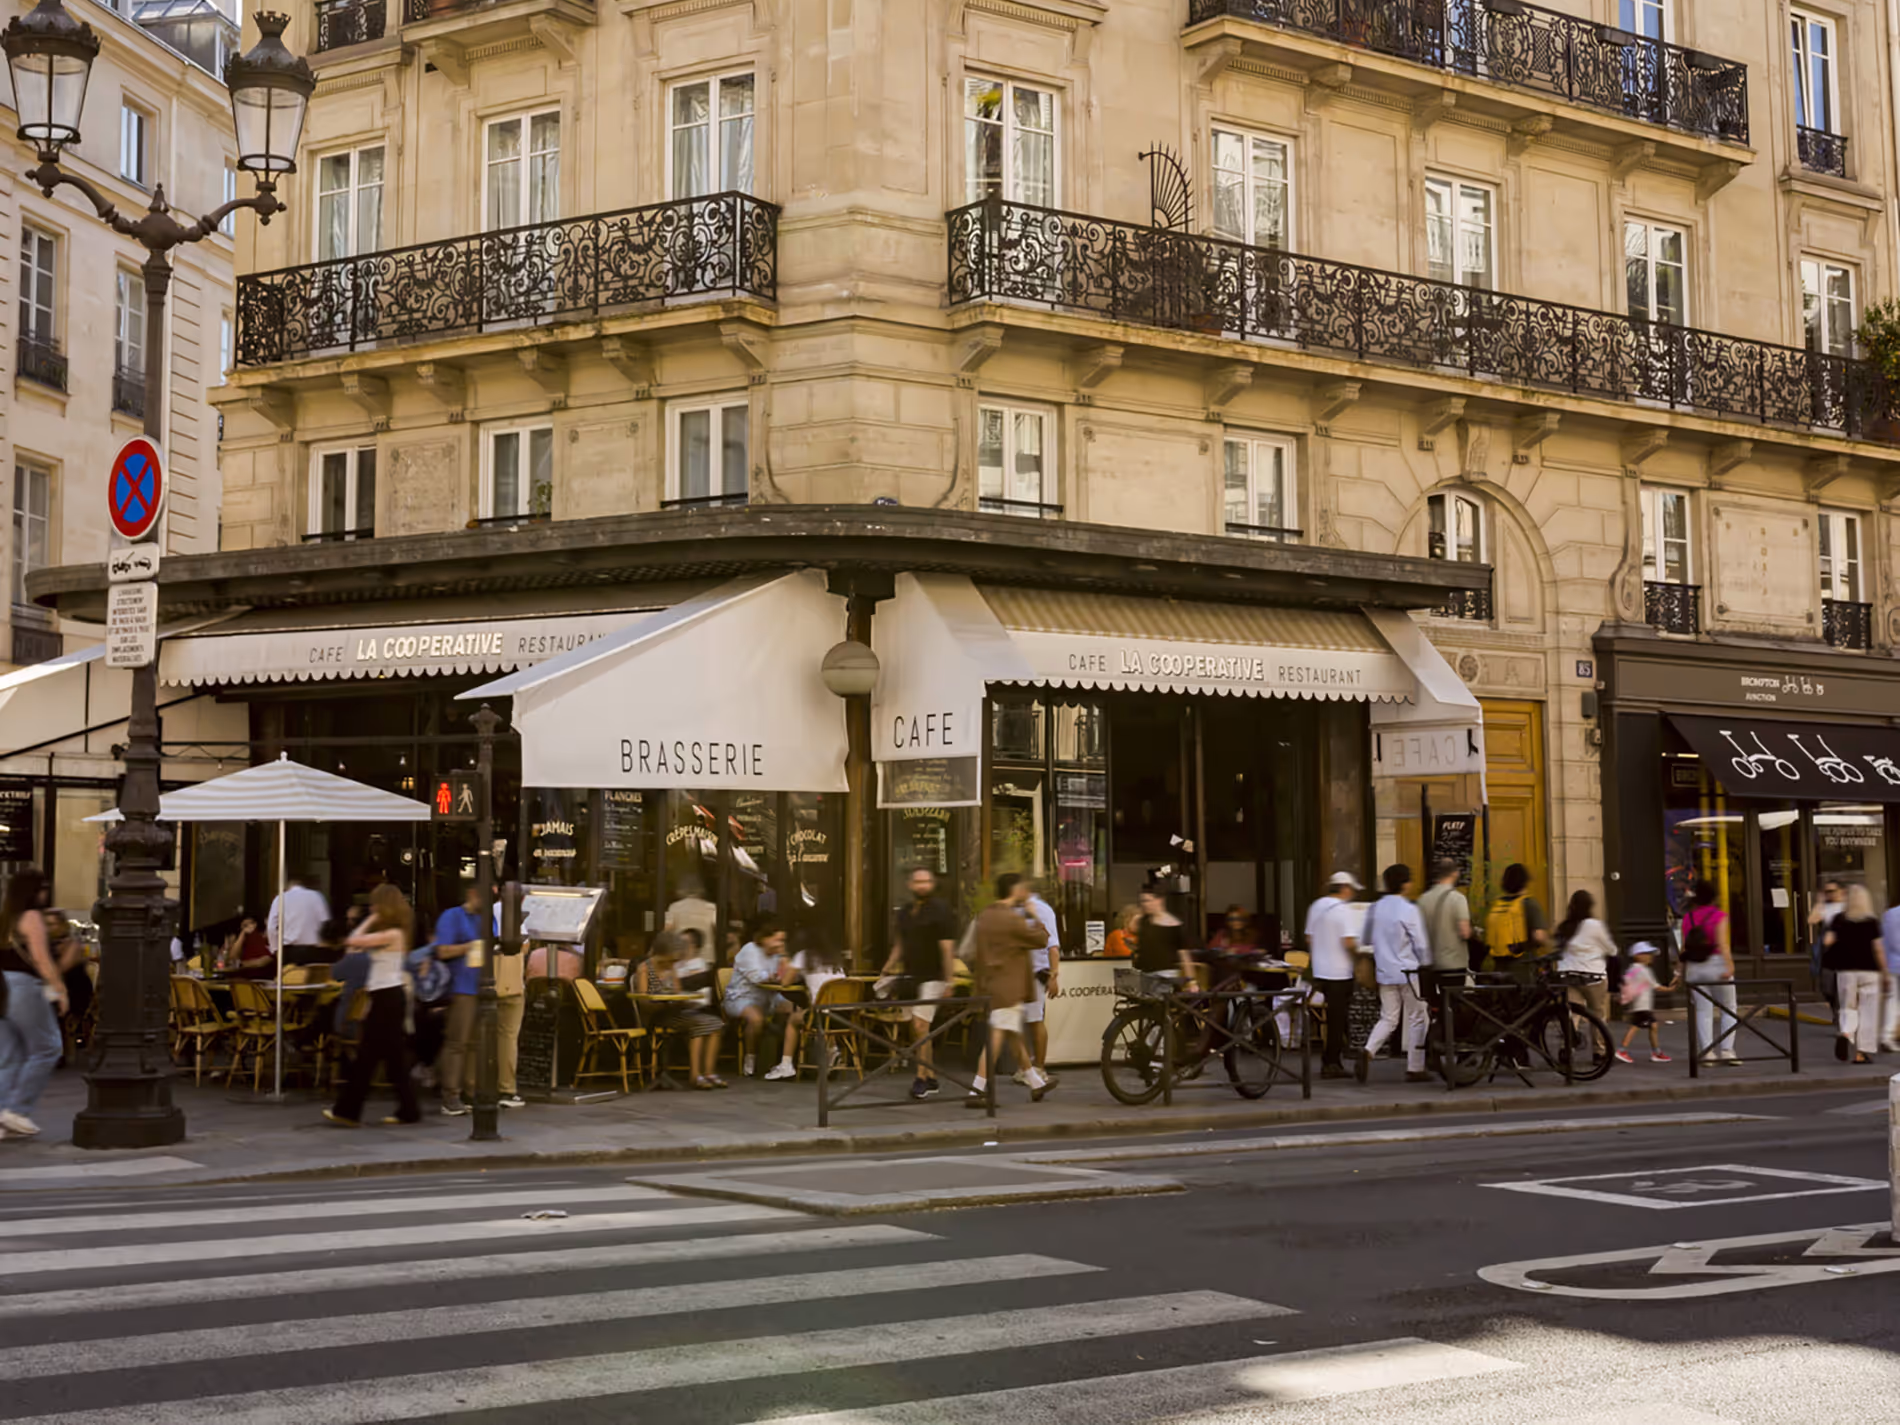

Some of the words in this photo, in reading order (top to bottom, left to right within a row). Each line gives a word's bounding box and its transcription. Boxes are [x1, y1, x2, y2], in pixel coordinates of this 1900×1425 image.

[309, 646, 344, 663] CAFE
[356, 637, 378, 661] LA
[383, 632, 504, 660] COOPERATIVE
[518, 633, 609, 653] RESTAURA
[1068, 653, 1106, 673] CAFE
[1120, 650, 1143, 675] LA
[1149, 652, 1264, 682] COOPERATIVE
[1278, 665, 1362, 685] RESTAURANT
[1578, 662, 1592, 676] 85
[1740, 676, 1780, 688] BROMPTON
[1745, 692, 1777, 703] JUNCTION
[893, 711, 955, 750] CAFE
[620, 738, 764, 777] BRASSERIE
[540, 820, 575, 837] JAMAIS
